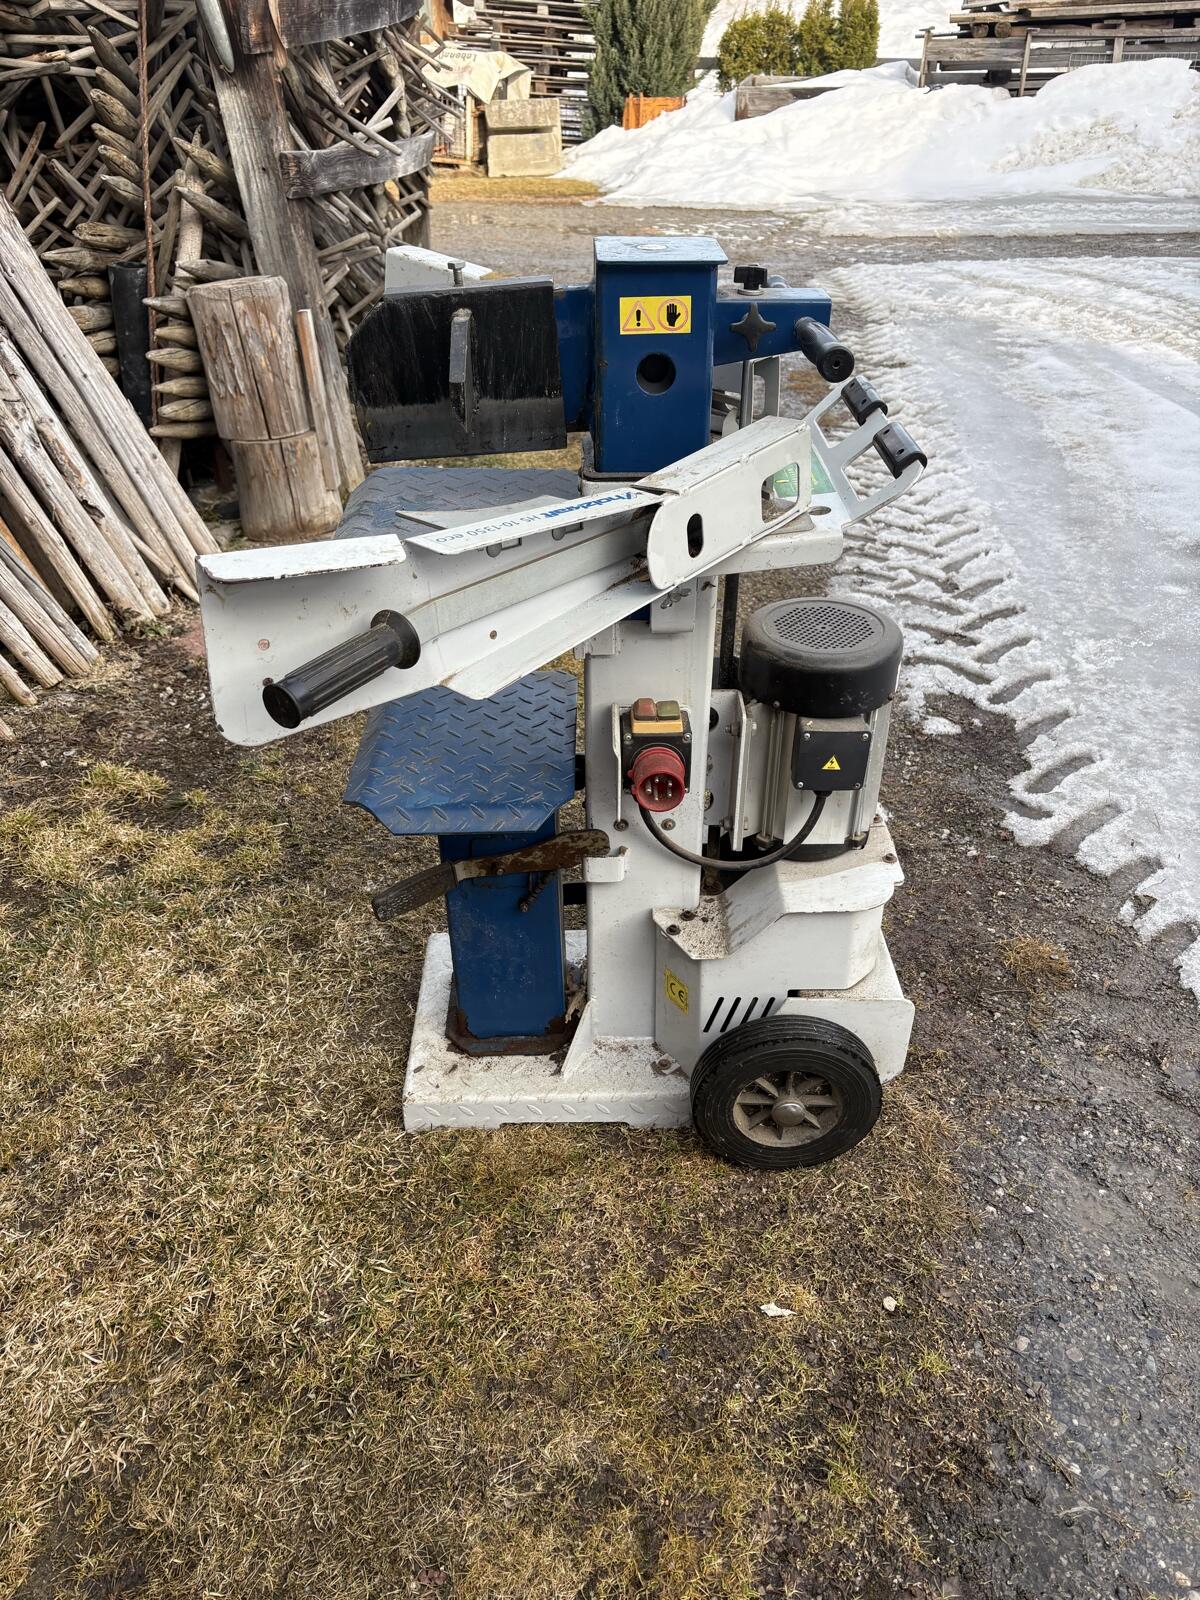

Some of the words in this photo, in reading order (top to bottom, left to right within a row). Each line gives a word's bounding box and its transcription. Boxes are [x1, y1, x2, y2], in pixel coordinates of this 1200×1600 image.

[520, 514, 541, 524] HS
[466, 520, 520, 536] 10-1350
[436, 533, 464, 543] eco
